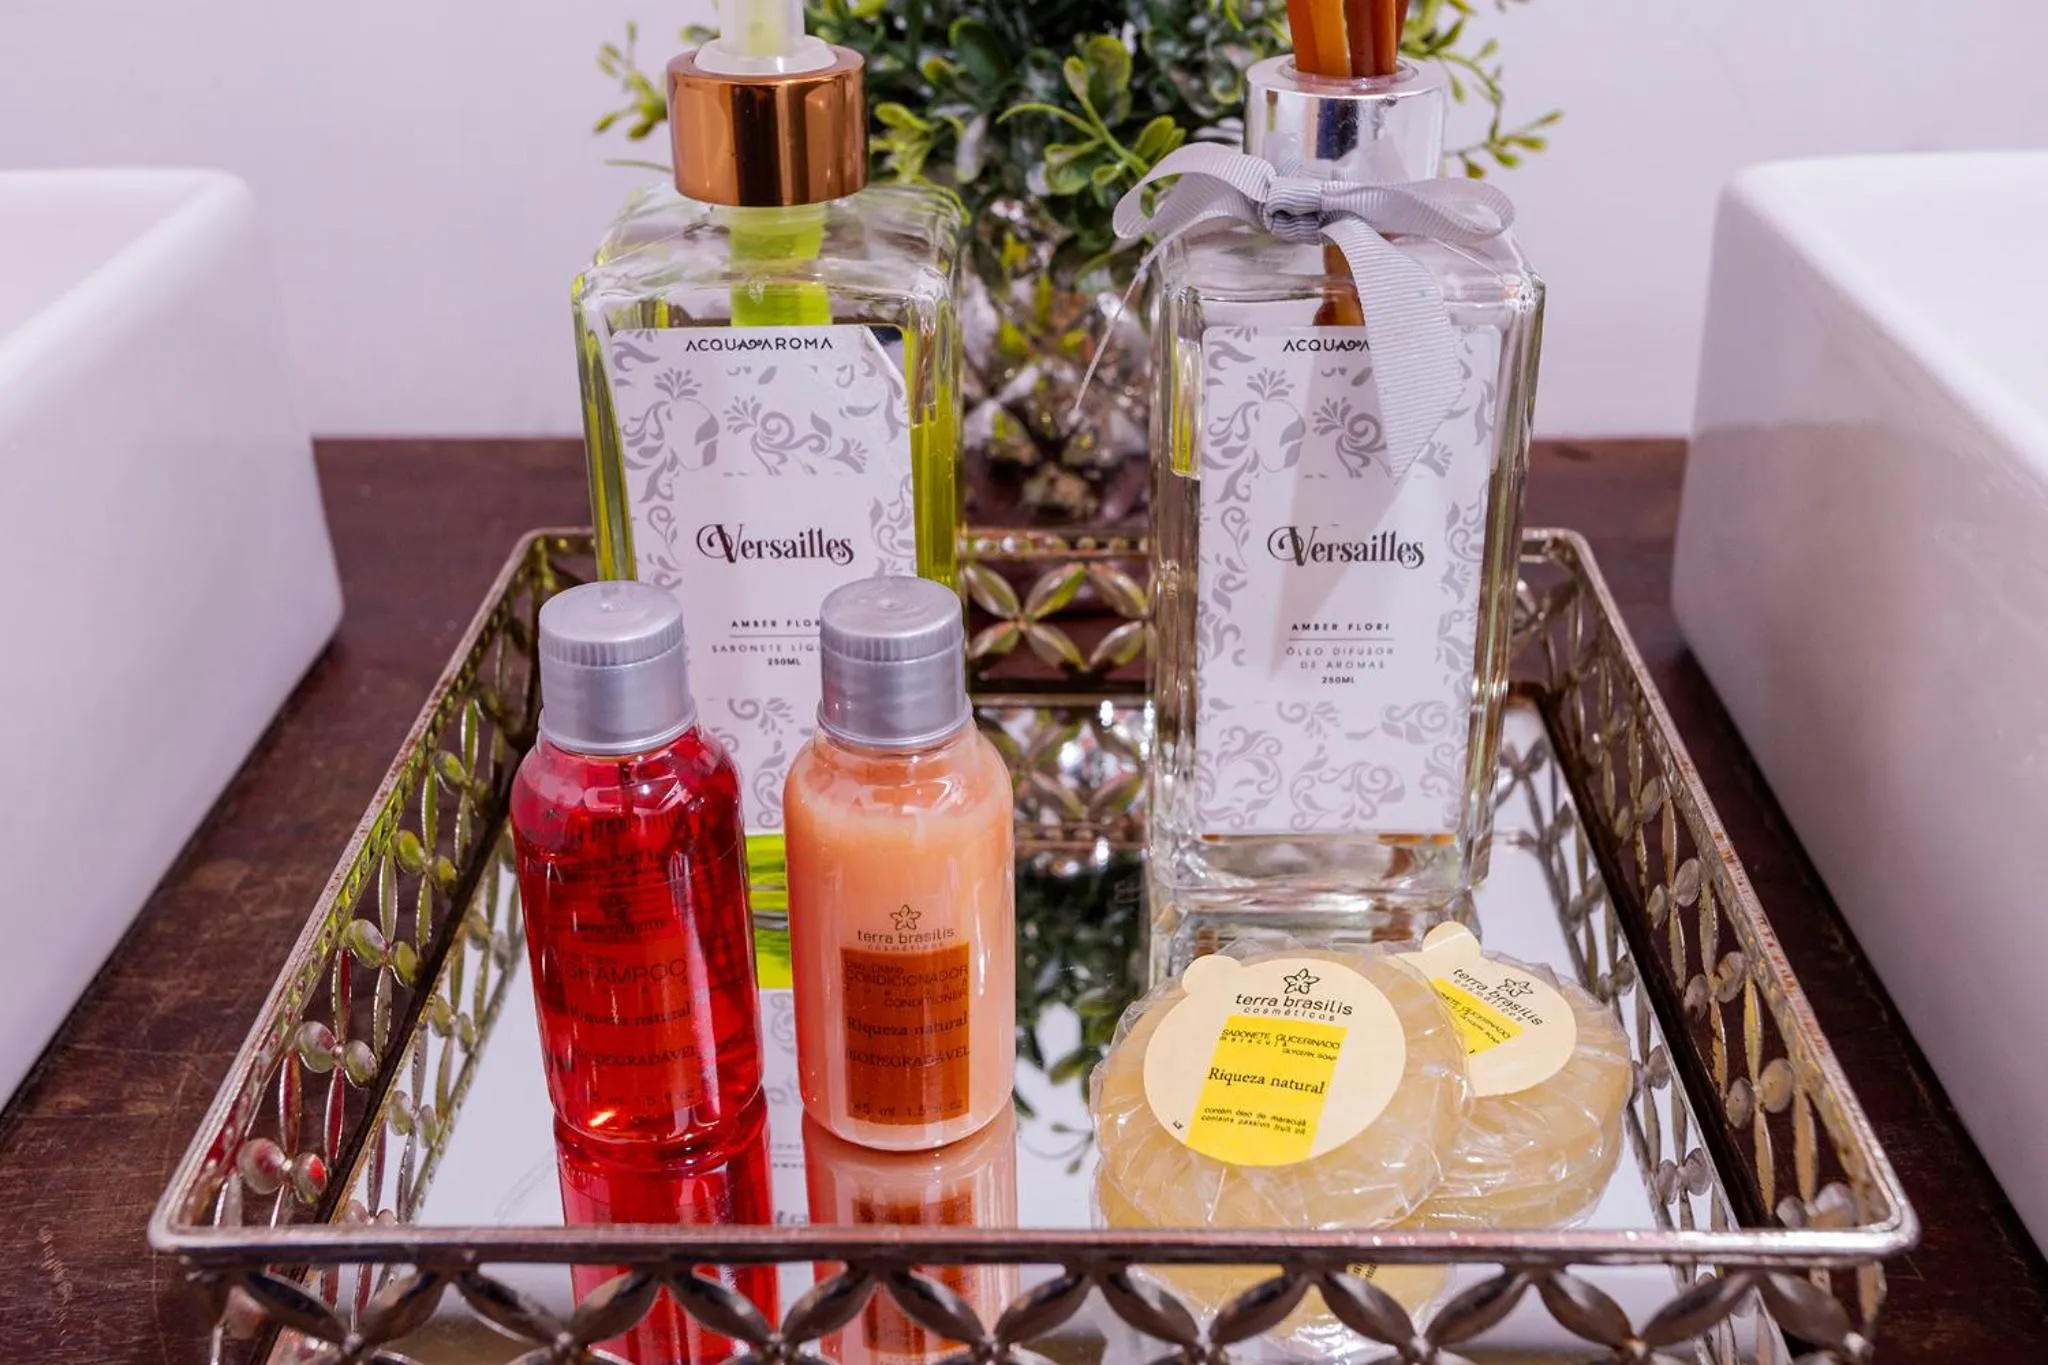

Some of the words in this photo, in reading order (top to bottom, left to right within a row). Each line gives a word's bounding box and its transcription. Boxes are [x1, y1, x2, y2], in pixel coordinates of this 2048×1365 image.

[696, 522, 854, 566] Versailles
[1267, 525, 1425, 570] Versailles
[731, 619, 777, 628] AMBER
[786, 619, 820, 627] FLOR
[1291, 622, 1338, 631] AMBER
[1348, 622, 1390, 631] FLORI
[711, 644, 782, 653] SABONETE
[1332, 646, 1394, 656] DIFUSOR
[767, 657, 801, 666] 250ML
[1300, 660, 1316, 670] DE
[1326, 660, 1384, 670] AROMAS
[1321, 675, 1354, 684] 250ML
[857, 929, 893, 945] terra
[898, 927, 956, 944] brasilis
[564, 957, 688, 984] SHAMPOO
[1235, 992, 1279, 1007] terra
[1282, 995, 1354, 1016] brasilis
[1452, 967, 1489, 991] terra
[1487, 988, 1544, 1027] brasilis
[1243, 1006, 1336, 1022] cosméticos
[848, 1015, 908, 1039] Riqueza
[913, 1009, 968, 1035] natural
[1221, 1028, 1272, 1041] SABONETE
[1207, 1066, 1266, 1086] Riqueza
[1270, 1076, 1326, 1095] natural
